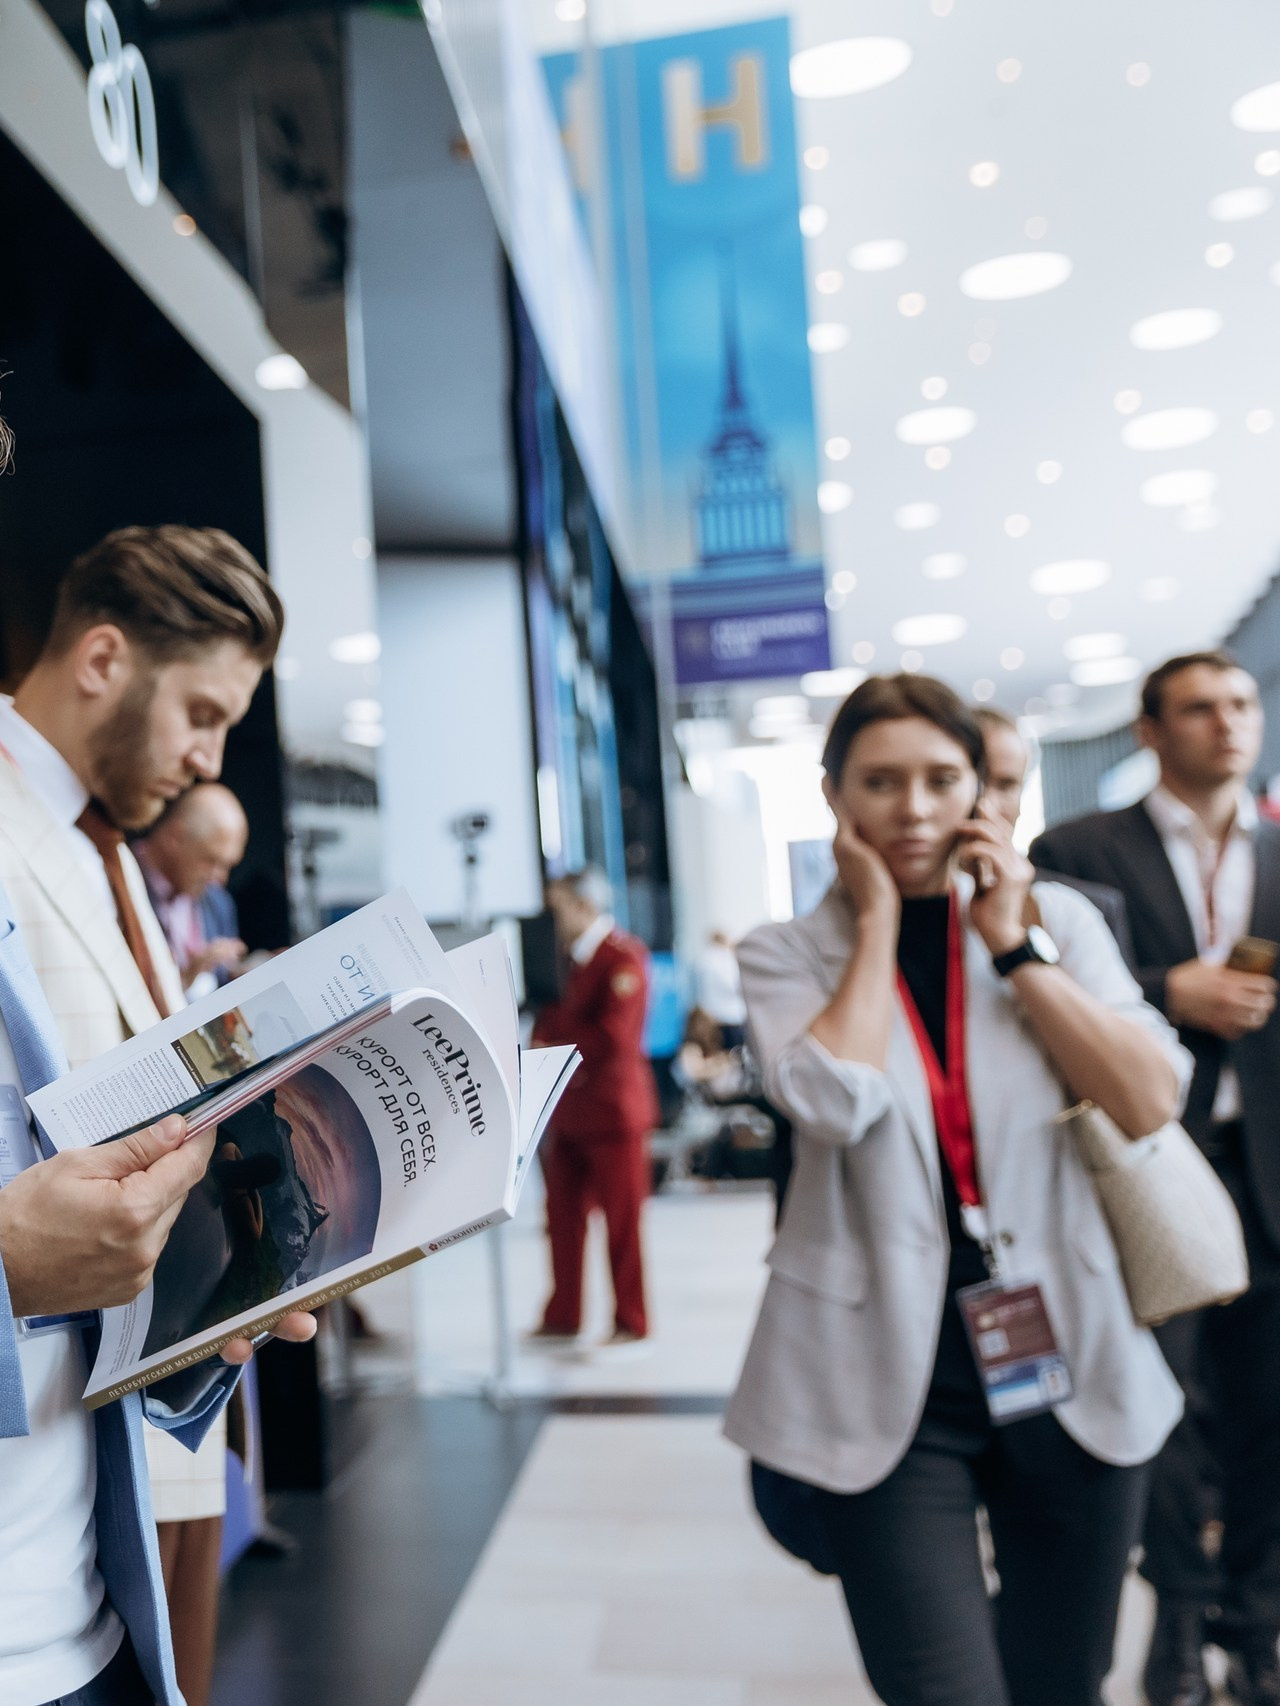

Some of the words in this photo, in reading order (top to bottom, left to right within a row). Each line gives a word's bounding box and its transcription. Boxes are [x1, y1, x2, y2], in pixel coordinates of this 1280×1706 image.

[85, 0, 160, 207] 80
[340, 955, 364, 979] ОТ
[332, 1044, 389, 1089] КУРОРТ
[378, 1094, 409, 1135] ДЛЯ
[400, 1138, 417, 1188] СЕБЯ.
[356, 1036, 413, 1087] КУРОРТ
[406, 1091, 427, 1116] ОТ
[417, 1120, 436, 1172] ВСЕХ.
[411, 1013, 486, 1137] LeePrime
[422, 1049, 461, 1115] residences
[437, 1218, 493, 1247] РОСКОНГРЕСС
[108, 1363, 174, 1398] ПЕТЕРБУРГСКИЙ
[330, 1278, 362, 1297] ФОРУМ
[370, 1264, 392, 1279] 2024
